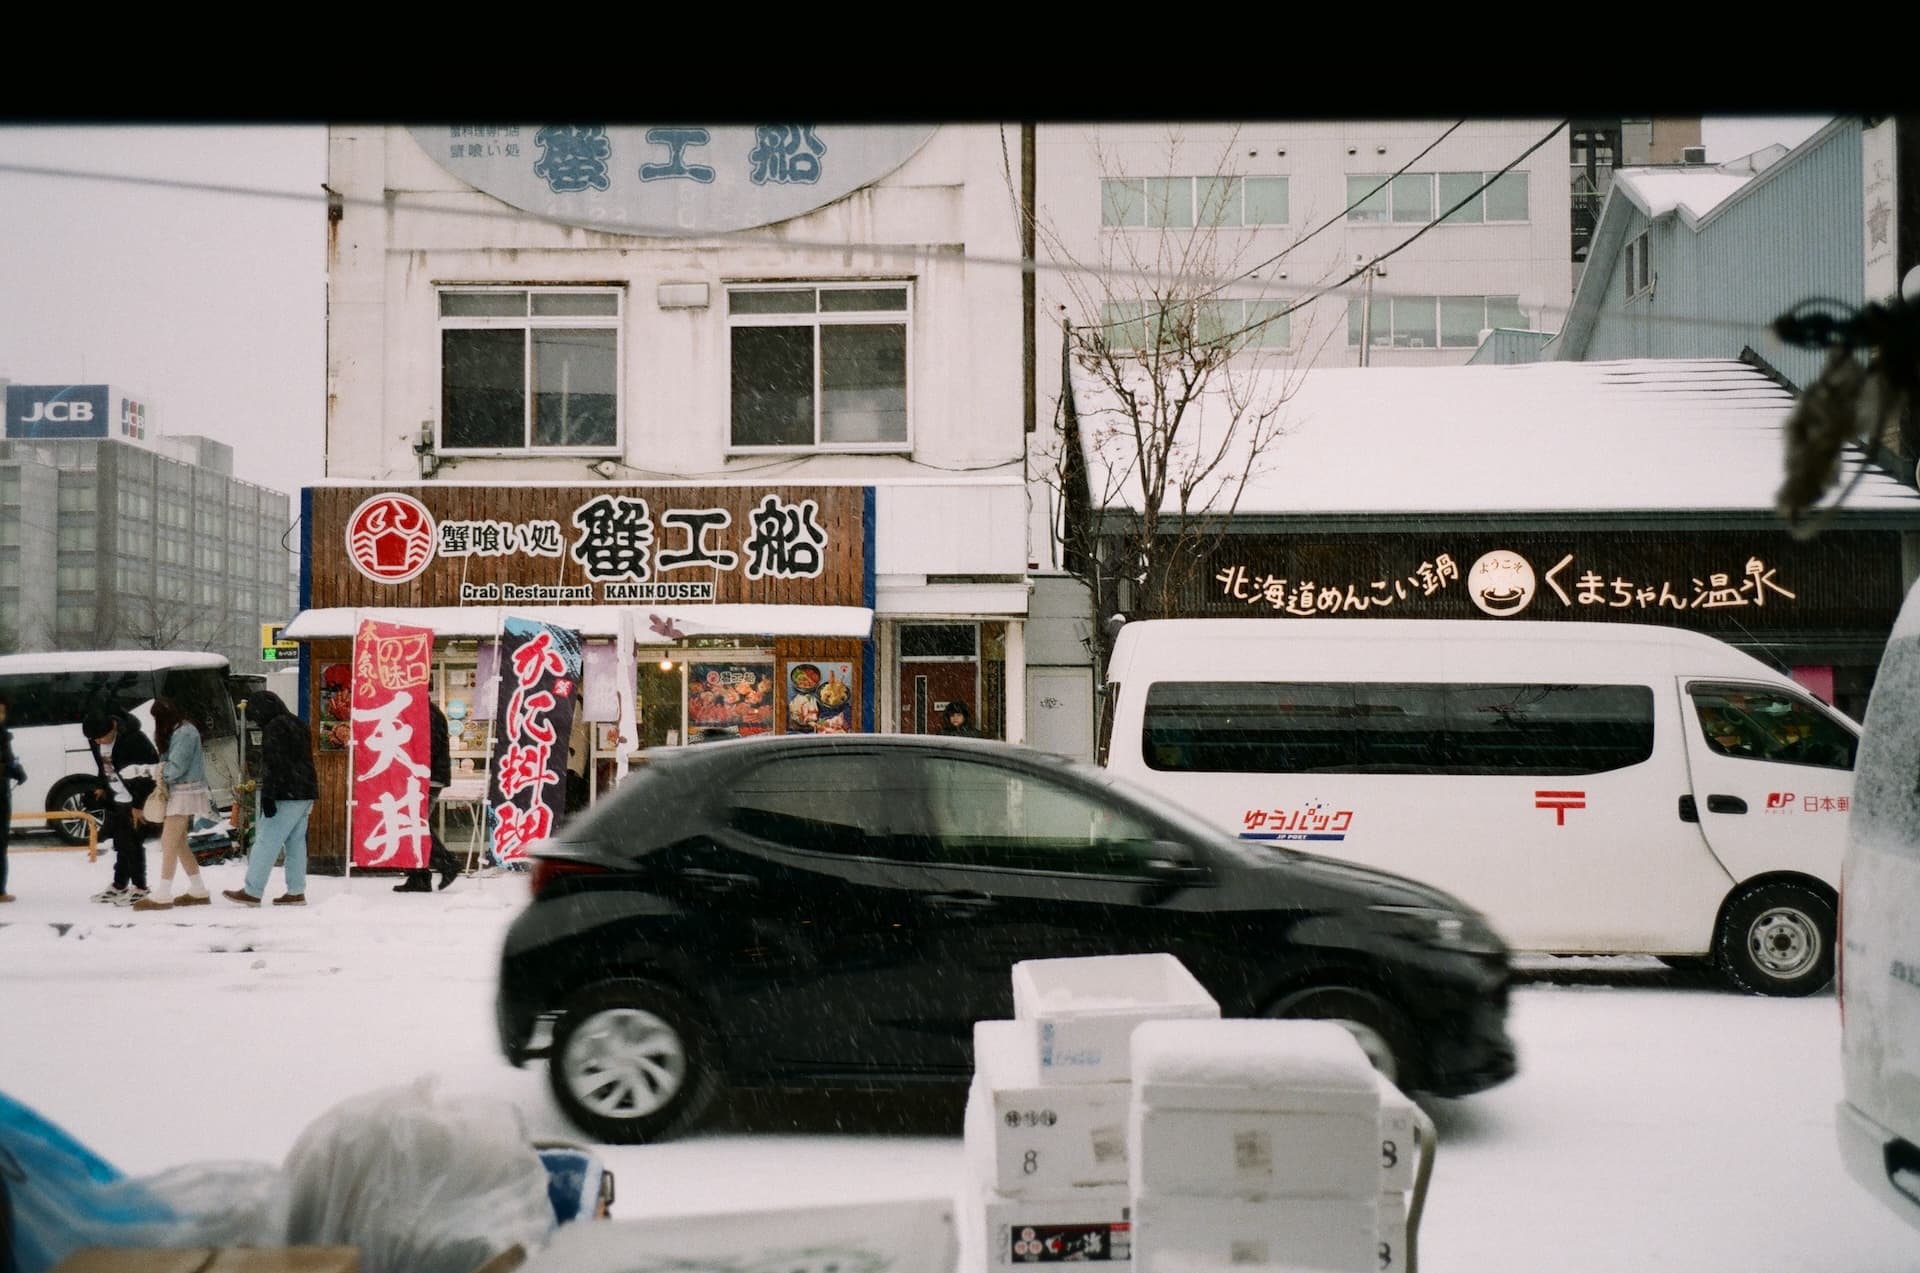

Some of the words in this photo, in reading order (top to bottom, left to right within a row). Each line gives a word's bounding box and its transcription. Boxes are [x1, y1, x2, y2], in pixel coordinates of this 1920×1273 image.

[21, 401, 94, 422] JCB
[440, 523, 561, 553] 蟹喰い処
[574, 497, 826, 580] 蟹工船
[1479, 558, 1523, 575] ようこそ
[462, 584, 499, 599] Crab
[504, 584, 592, 599] Restaurant
[606, 584, 712, 599] KANIKOUSEN
[1215, 553, 1460, 615] 北海道めんこい鍋
[1544, 552, 1796, 610] くまちゃん温泉
[493, 632, 566, 861] かに料理
[1243, 807, 1354, 831] ゆうパック
[1023, 1149, 1038, 1175] 8
